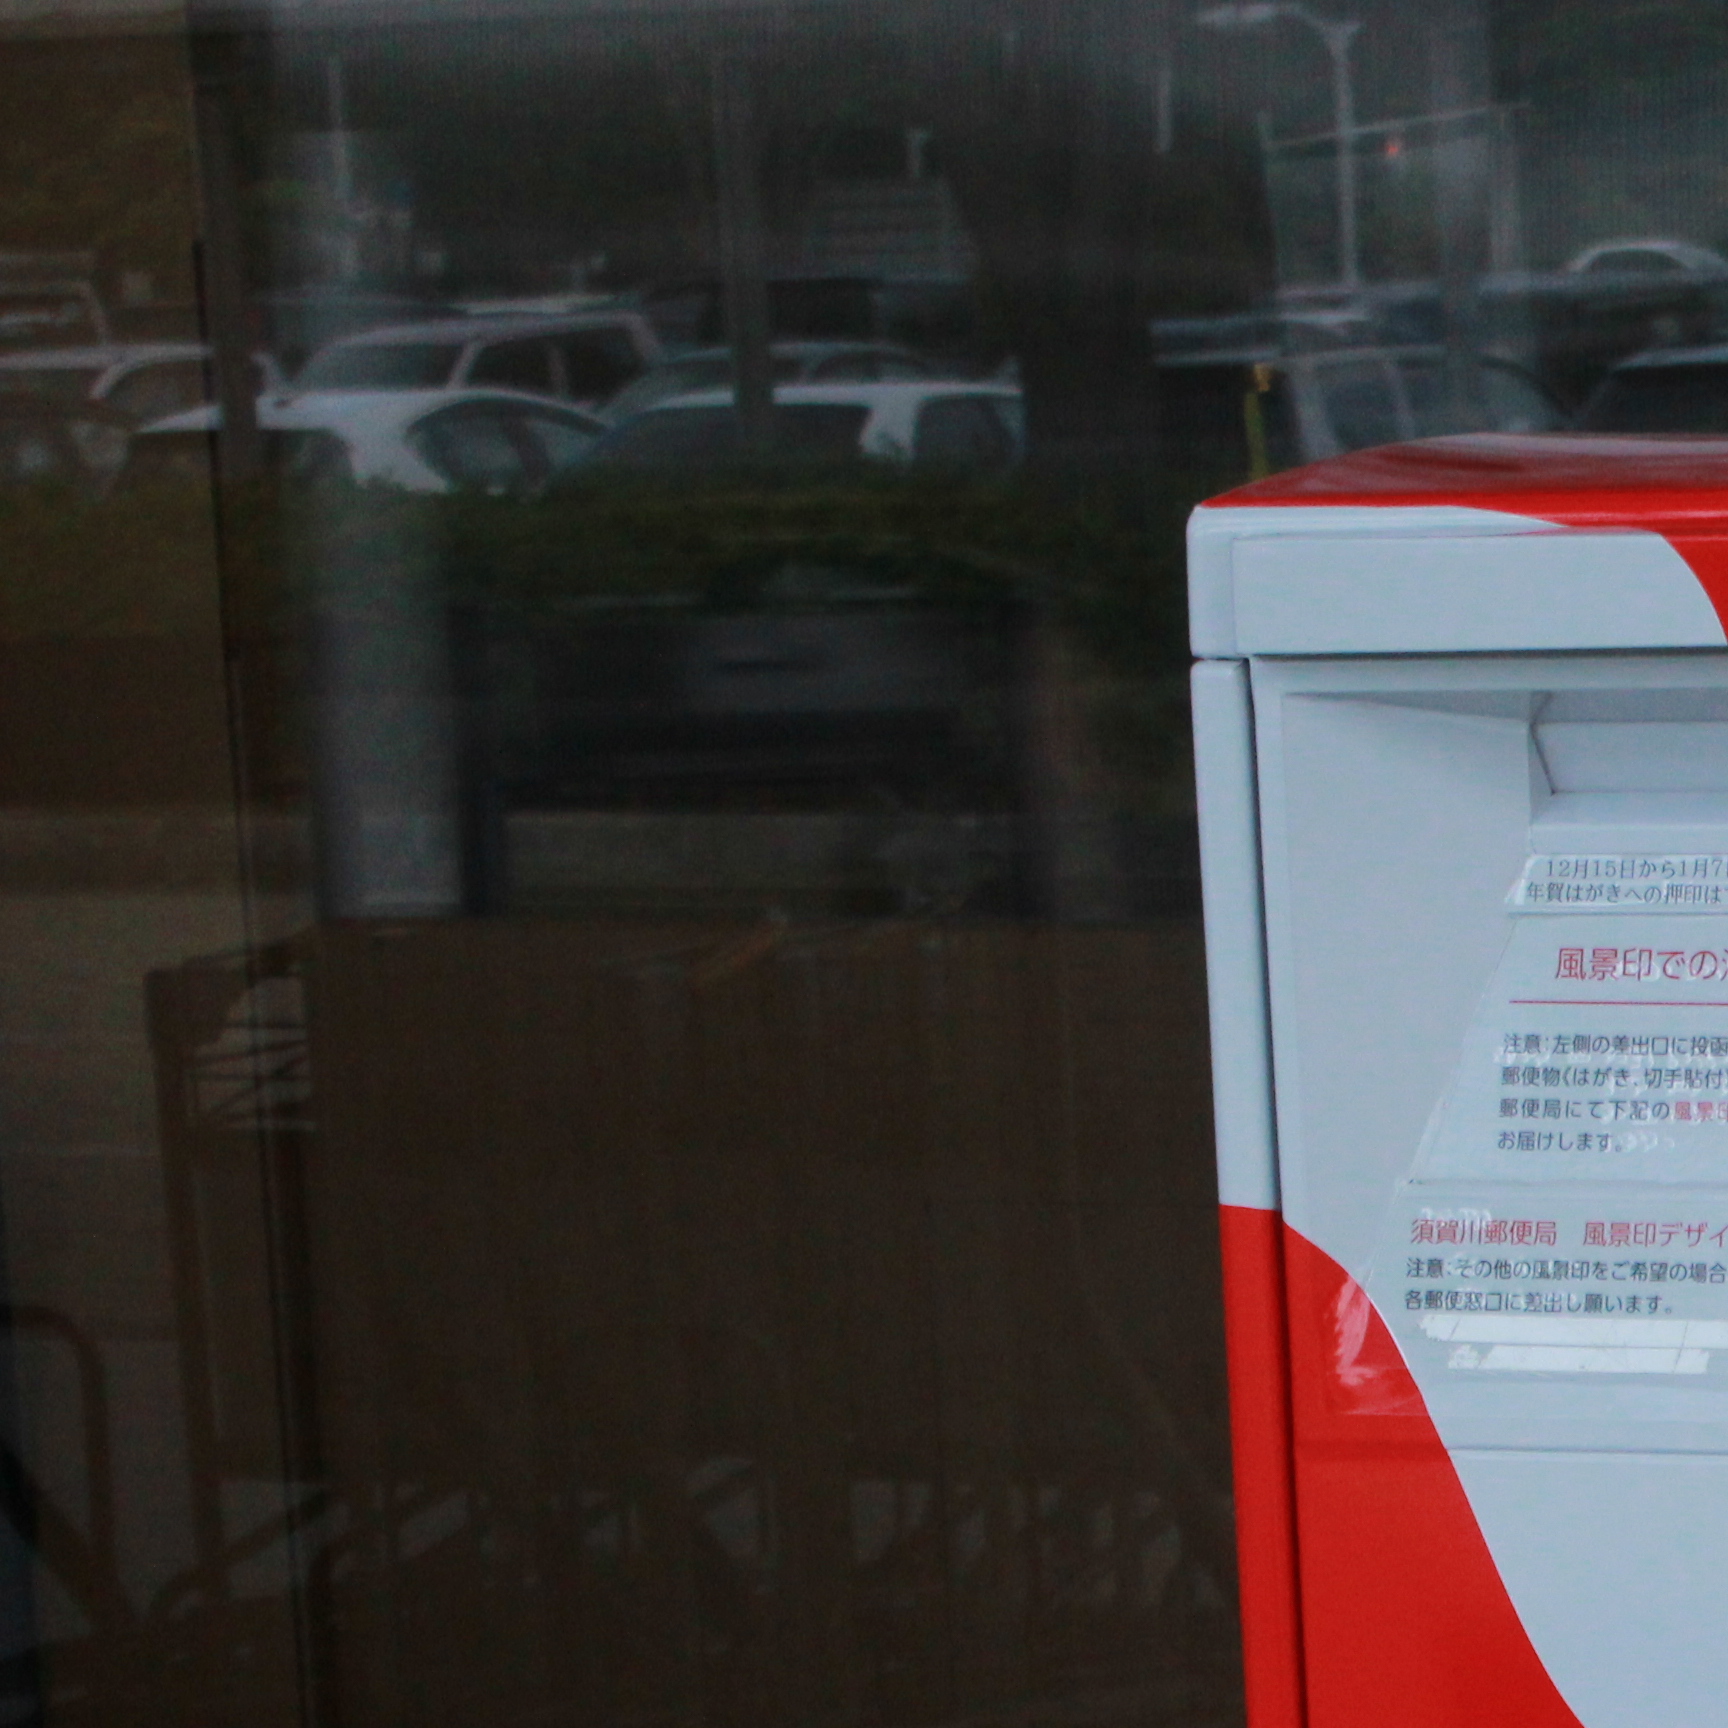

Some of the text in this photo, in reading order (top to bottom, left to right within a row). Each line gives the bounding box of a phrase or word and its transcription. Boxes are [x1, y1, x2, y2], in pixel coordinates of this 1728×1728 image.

[1497, 1131, 1624, 1152] お届けします。
[1410, 1217, 1557, 1247] 須賀川郵便局
[1405, 1289, 1673, 1316] 各郵便窓口に差出し願います。
